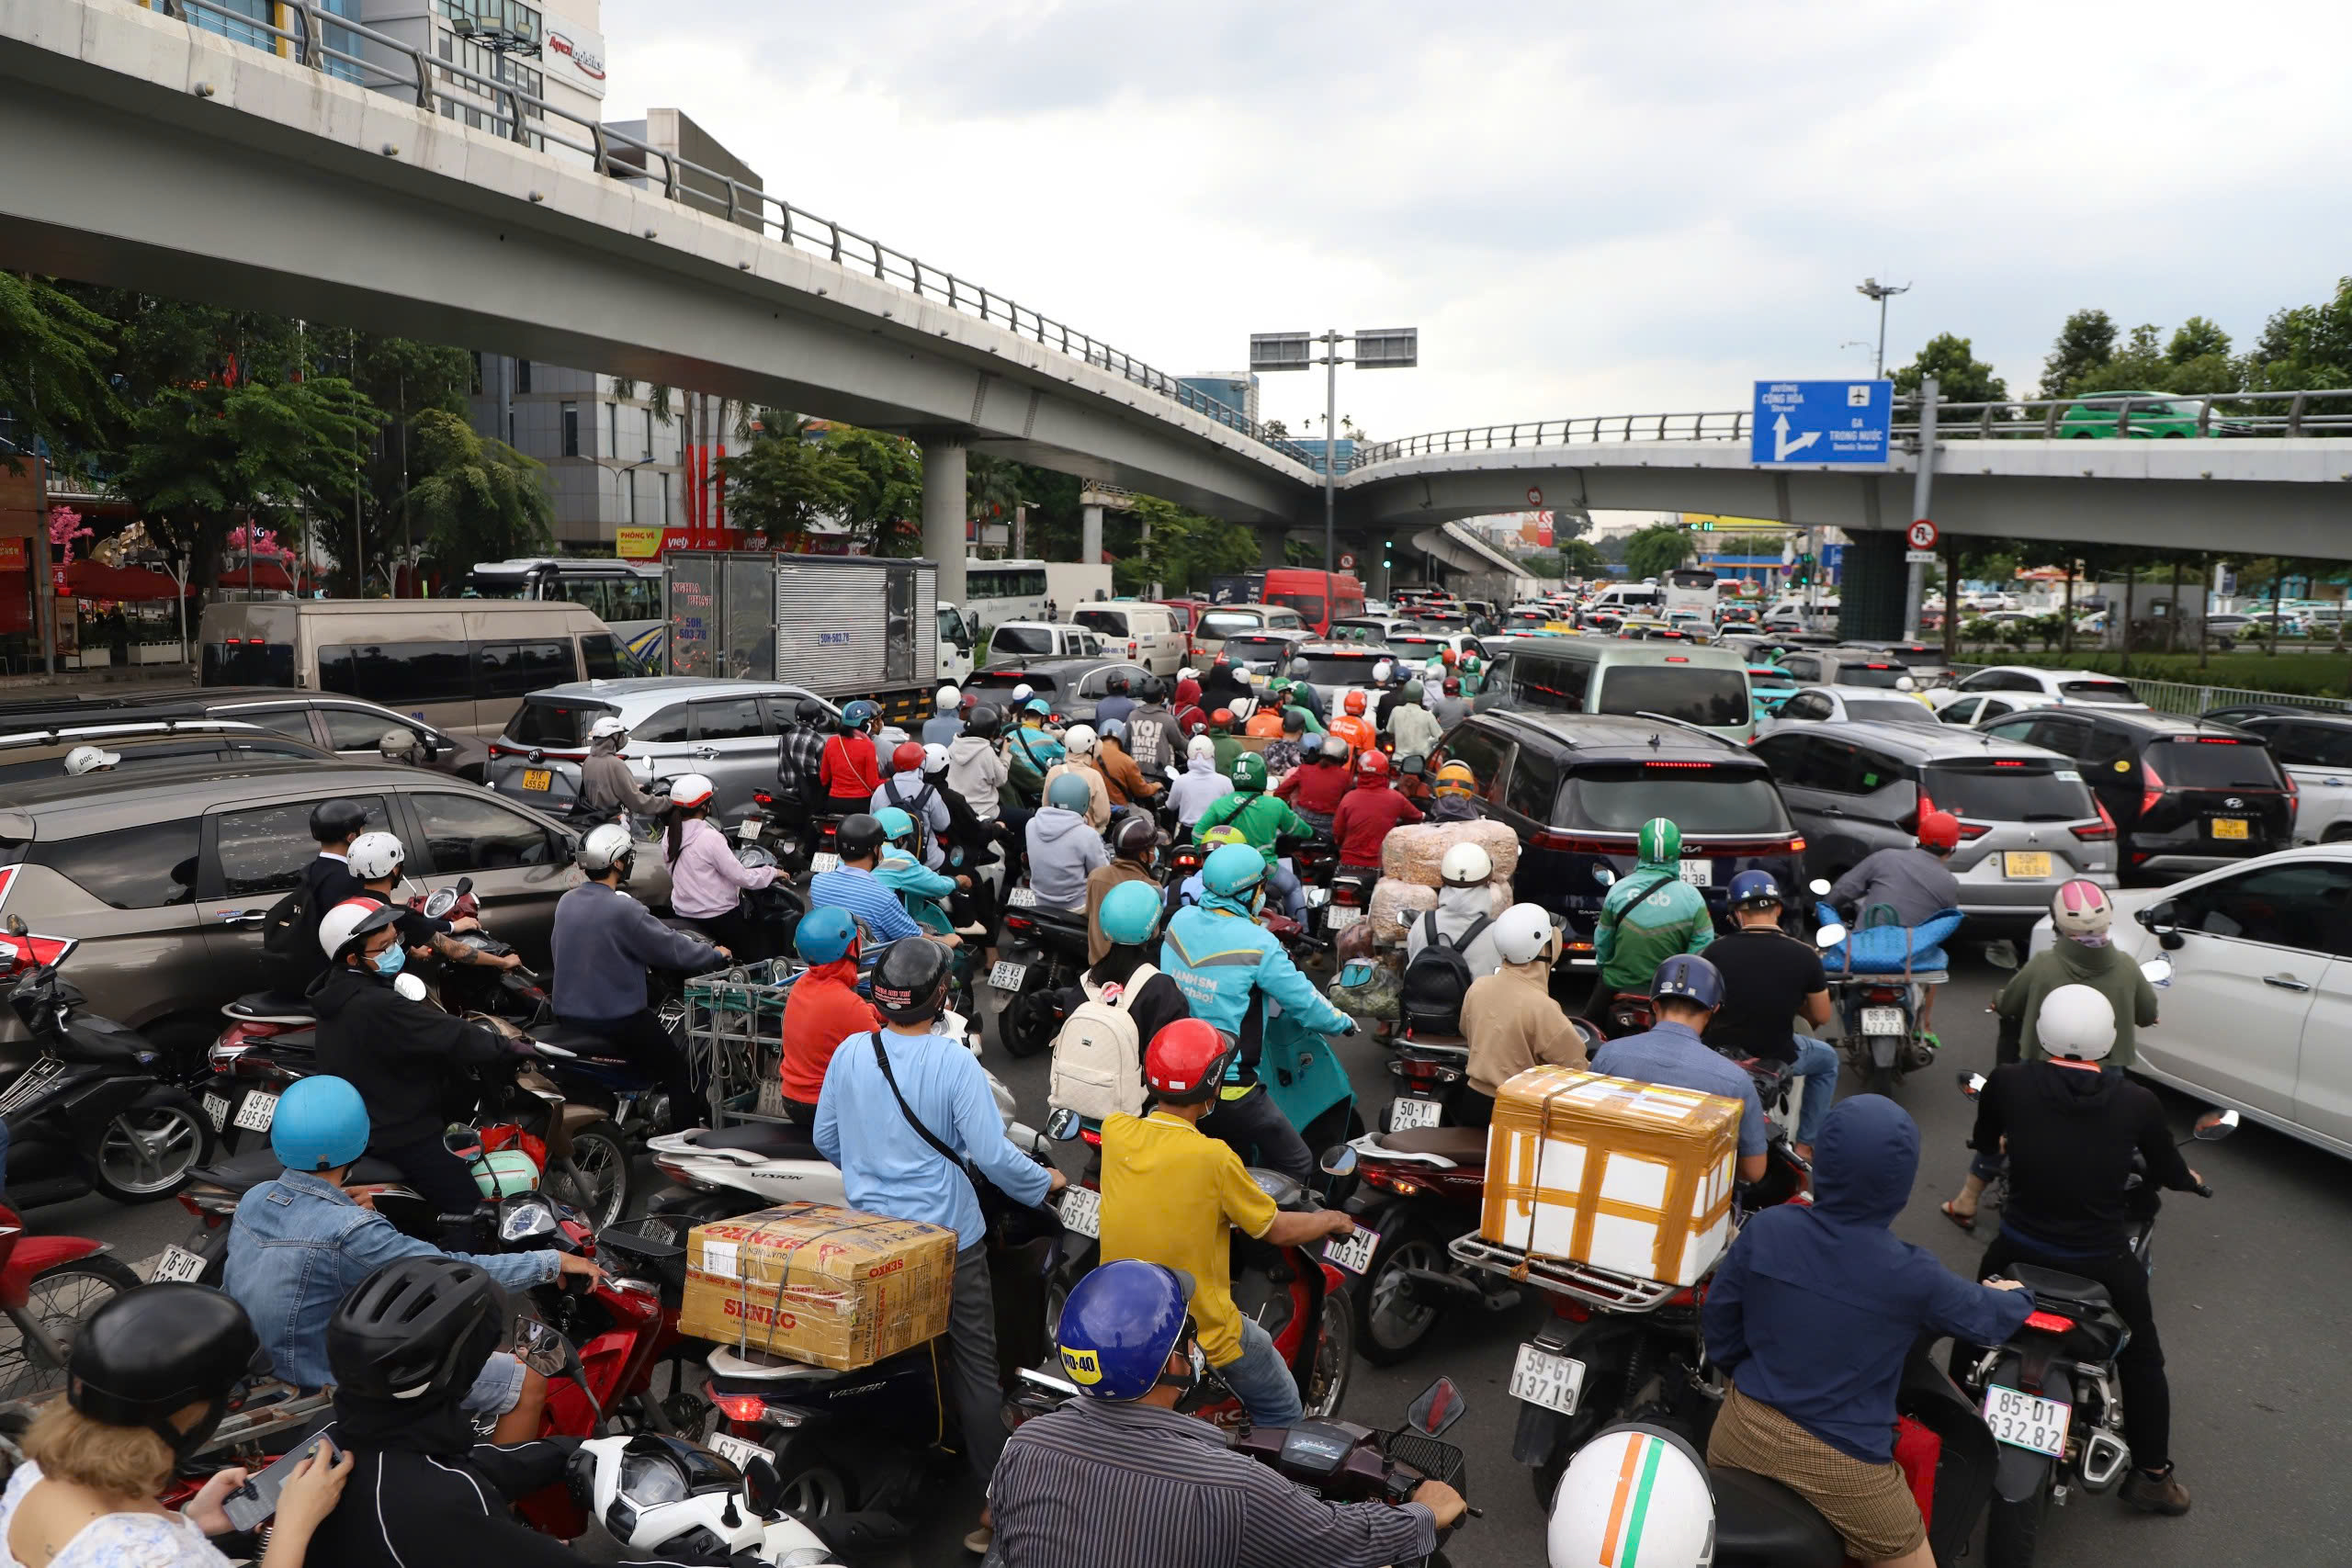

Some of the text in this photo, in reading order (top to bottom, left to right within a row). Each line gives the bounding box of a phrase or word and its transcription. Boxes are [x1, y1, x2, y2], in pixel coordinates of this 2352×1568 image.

[531, 772, 542, 781] 51K
[1232, 773, 1252, 781] Grab
[1627, 887, 1670, 907] Gab
[248, 1093, 276, 1113] 49-G1
[1399, 1101, 1433, 1119] 50-Y1
[237, 1109, 272, 1130] 395.96
[751, 1172, 804, 1181] VISION
[164, 1250, 198, 1280] 76-U1
[869, 1258, 903, 1279] SENKO
[723, 1298, 797, 1330] SENKO
[1524, 1349, 1572, 1384] 59-G1
[1514, 1372, 1574, 1410] 137.19
[1999, 1393, 2056, 1427] 85-D1
[1987, 1413, 2061, 1453] 632.82
